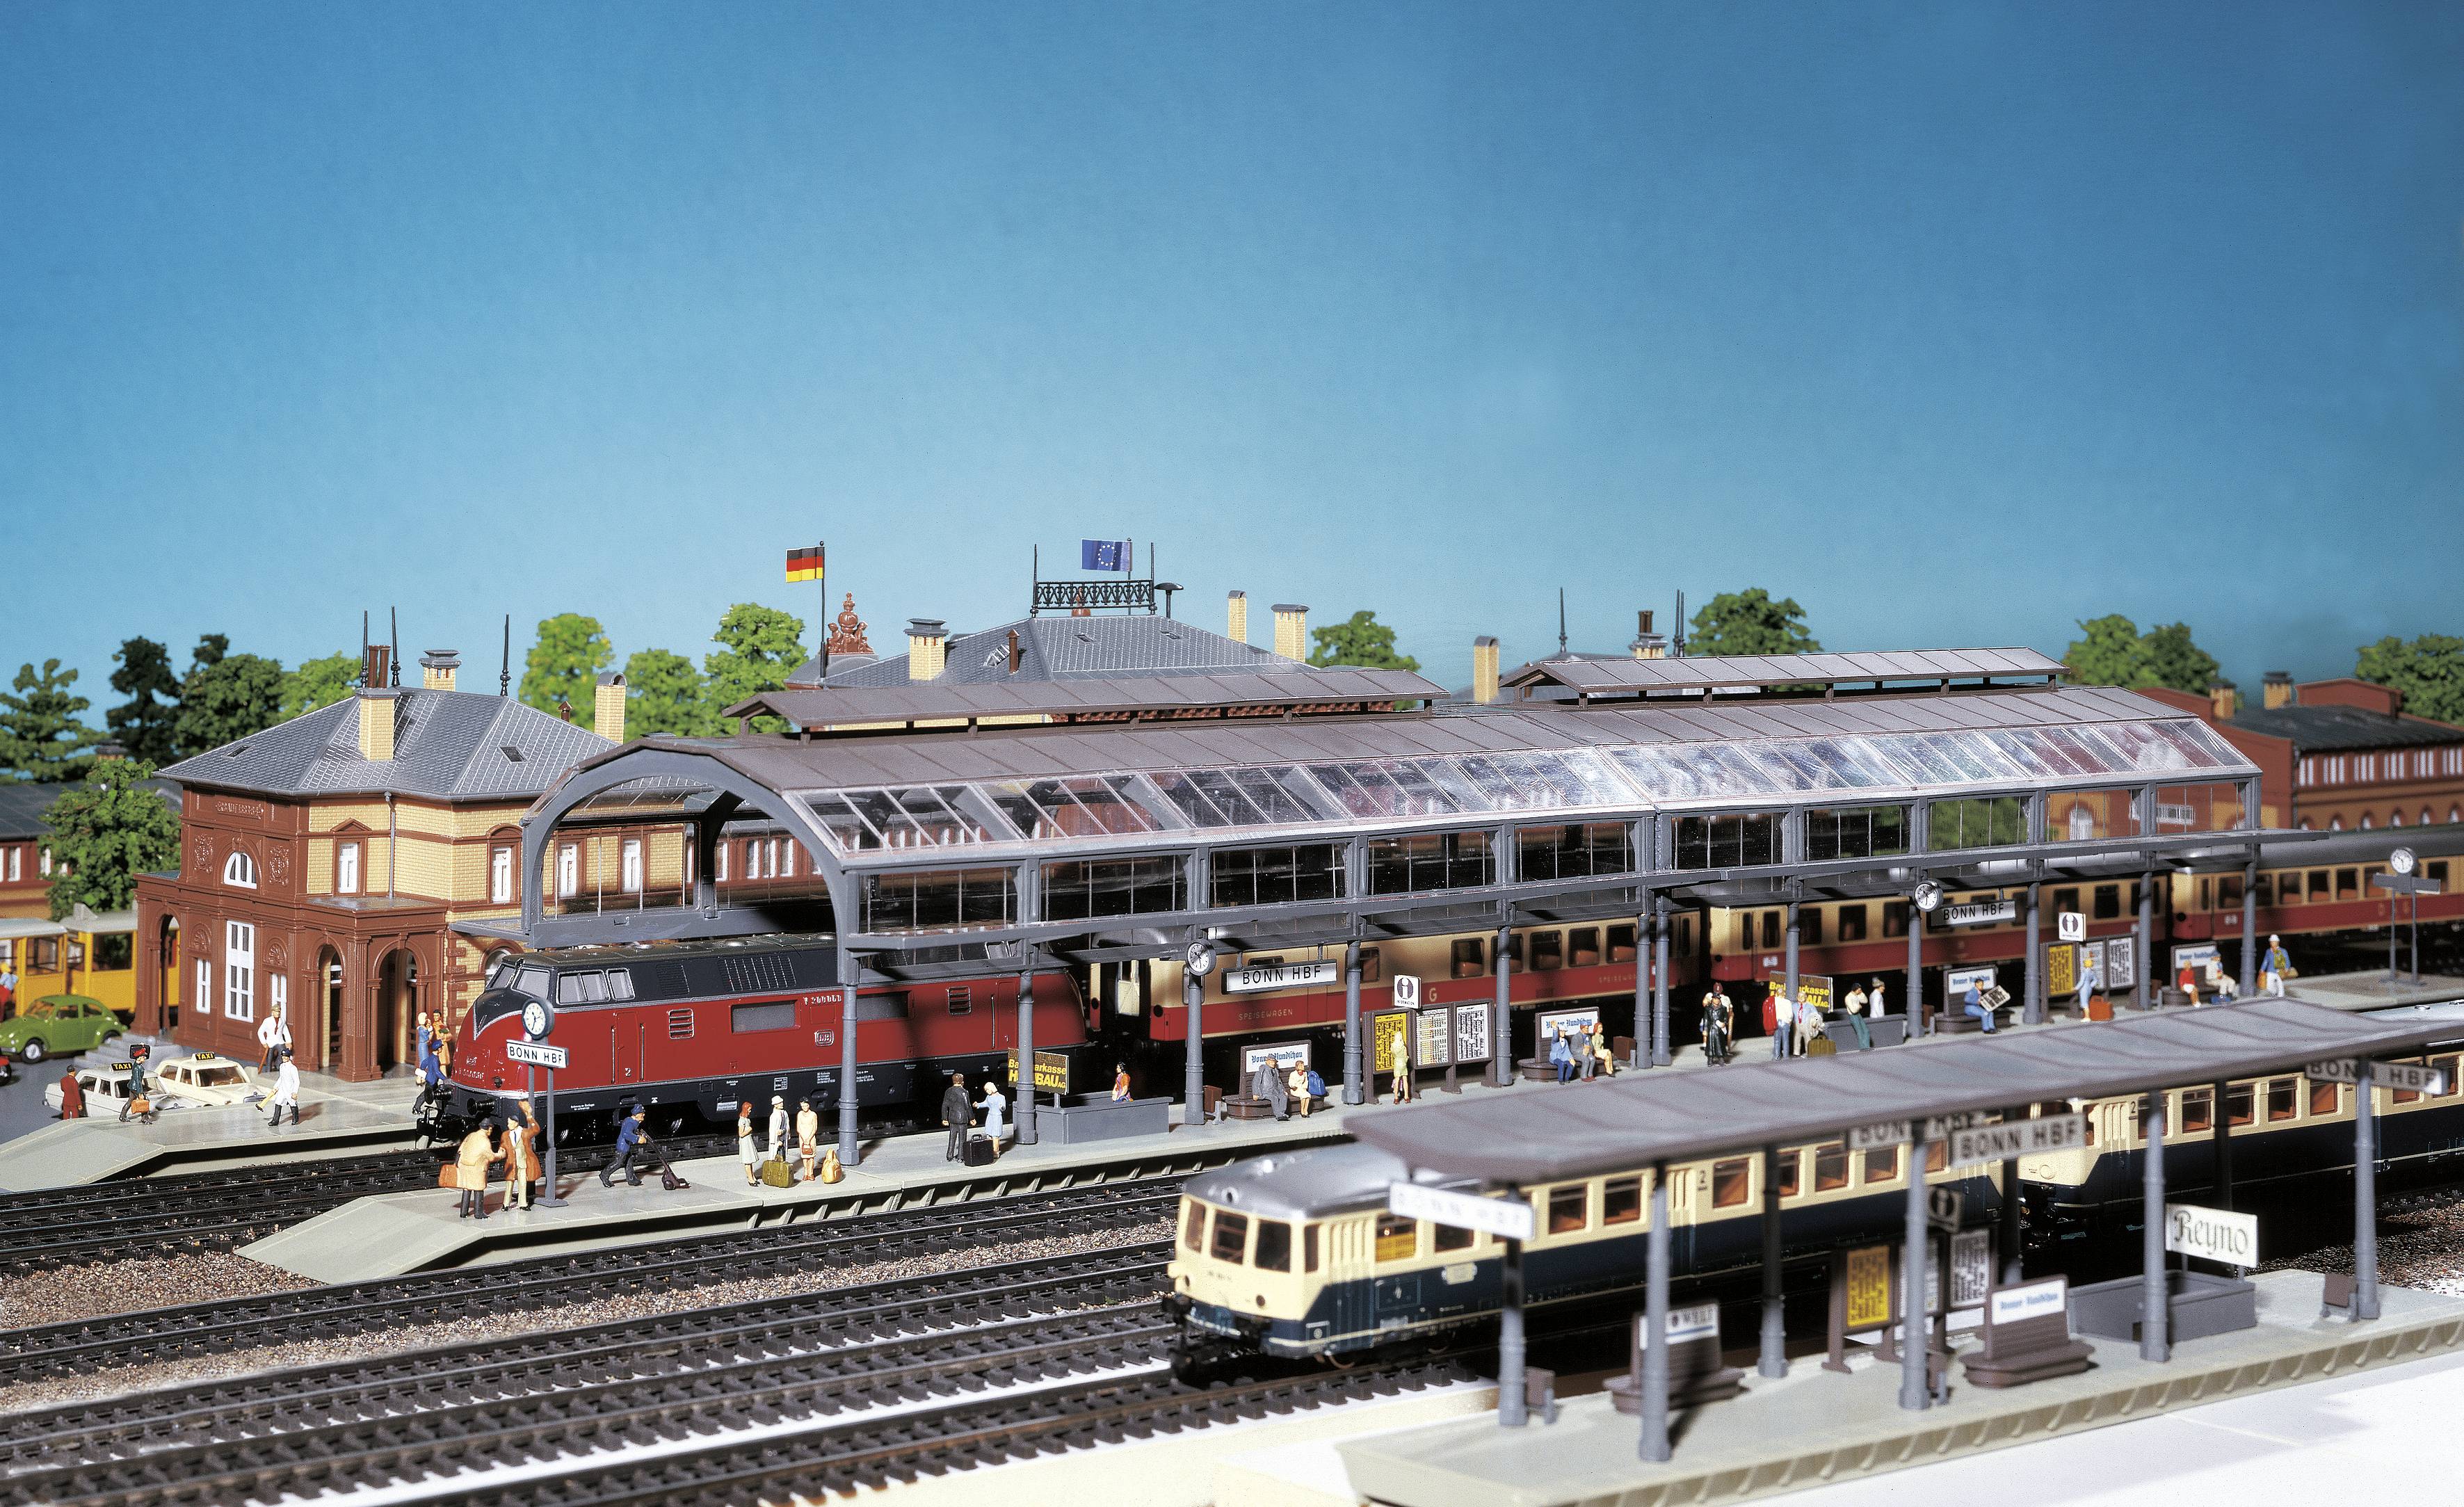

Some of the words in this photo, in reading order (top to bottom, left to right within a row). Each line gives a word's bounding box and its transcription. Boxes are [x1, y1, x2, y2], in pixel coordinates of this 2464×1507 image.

[1943, 906, 1976, 920] BONN
[1982, 903, 2004, 916] HBF
[1243, 969, 1283, 985] BONN
[1292, 965, 1321, 980] HBF
[1429, 988, 1438, 1002] G
[1238, 1008, 1293, 1021] SPEISEWAGEN
[510, 1046, 538, 1061] BONN
[544, 1052, 562, 1064] HBF
[1008, 1058, 1066, 1074] Baarkasse
[2130, 1101, 2136, 1113] 2
[1960, 1129, 2021, 1159] BONN
[2033, 1119, 2077, 1145] HBF
[1699, 1170, 1706, 1184] 2
[2174, 1210, 2248, 1255] Reyno
